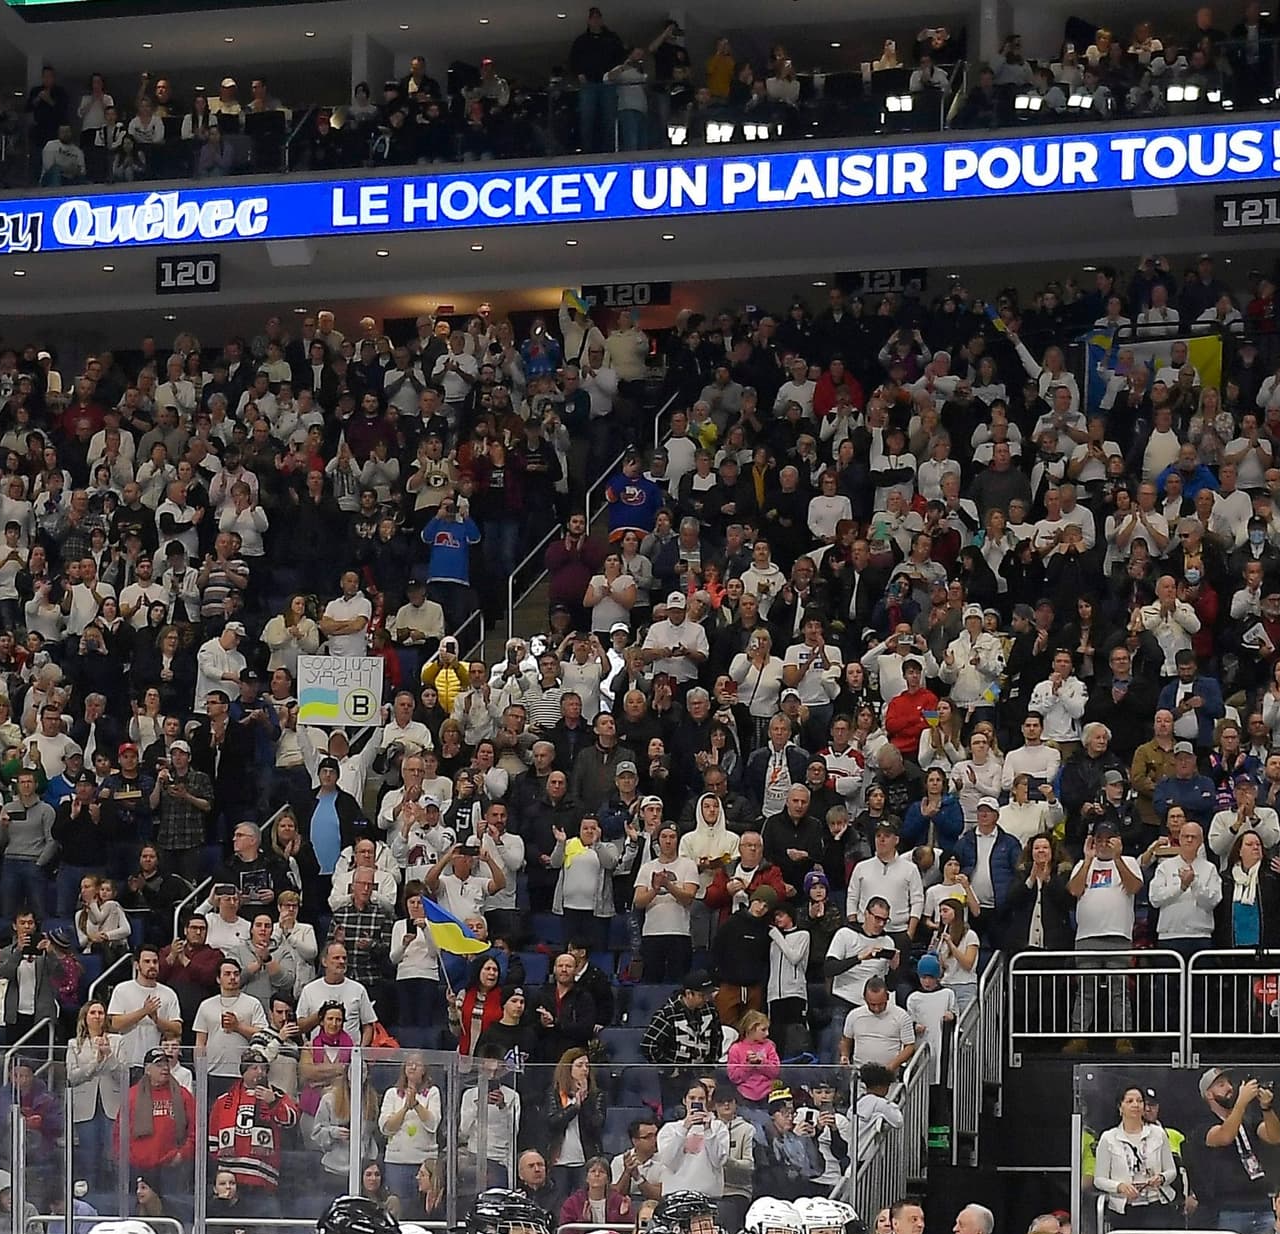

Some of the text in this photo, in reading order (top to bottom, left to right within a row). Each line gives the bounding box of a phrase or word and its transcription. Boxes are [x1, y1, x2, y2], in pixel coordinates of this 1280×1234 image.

[332, 185, 390, 227] LE
[403, 172, 618, 222] HOCKEY
[631, 165, 708, 211] UN
[722, 152, 928, 205] PLAISIR
[942, 142, 1099, 191] POUR
[53, 192, 269, 247] Québec
[1223, 198, 1280, 227] 121
[161, 260, 216, 287] 120
[861, 271, 902, 292] 121
[603, 284, 651, 306] 120
[352, 695, 369, 715] B
